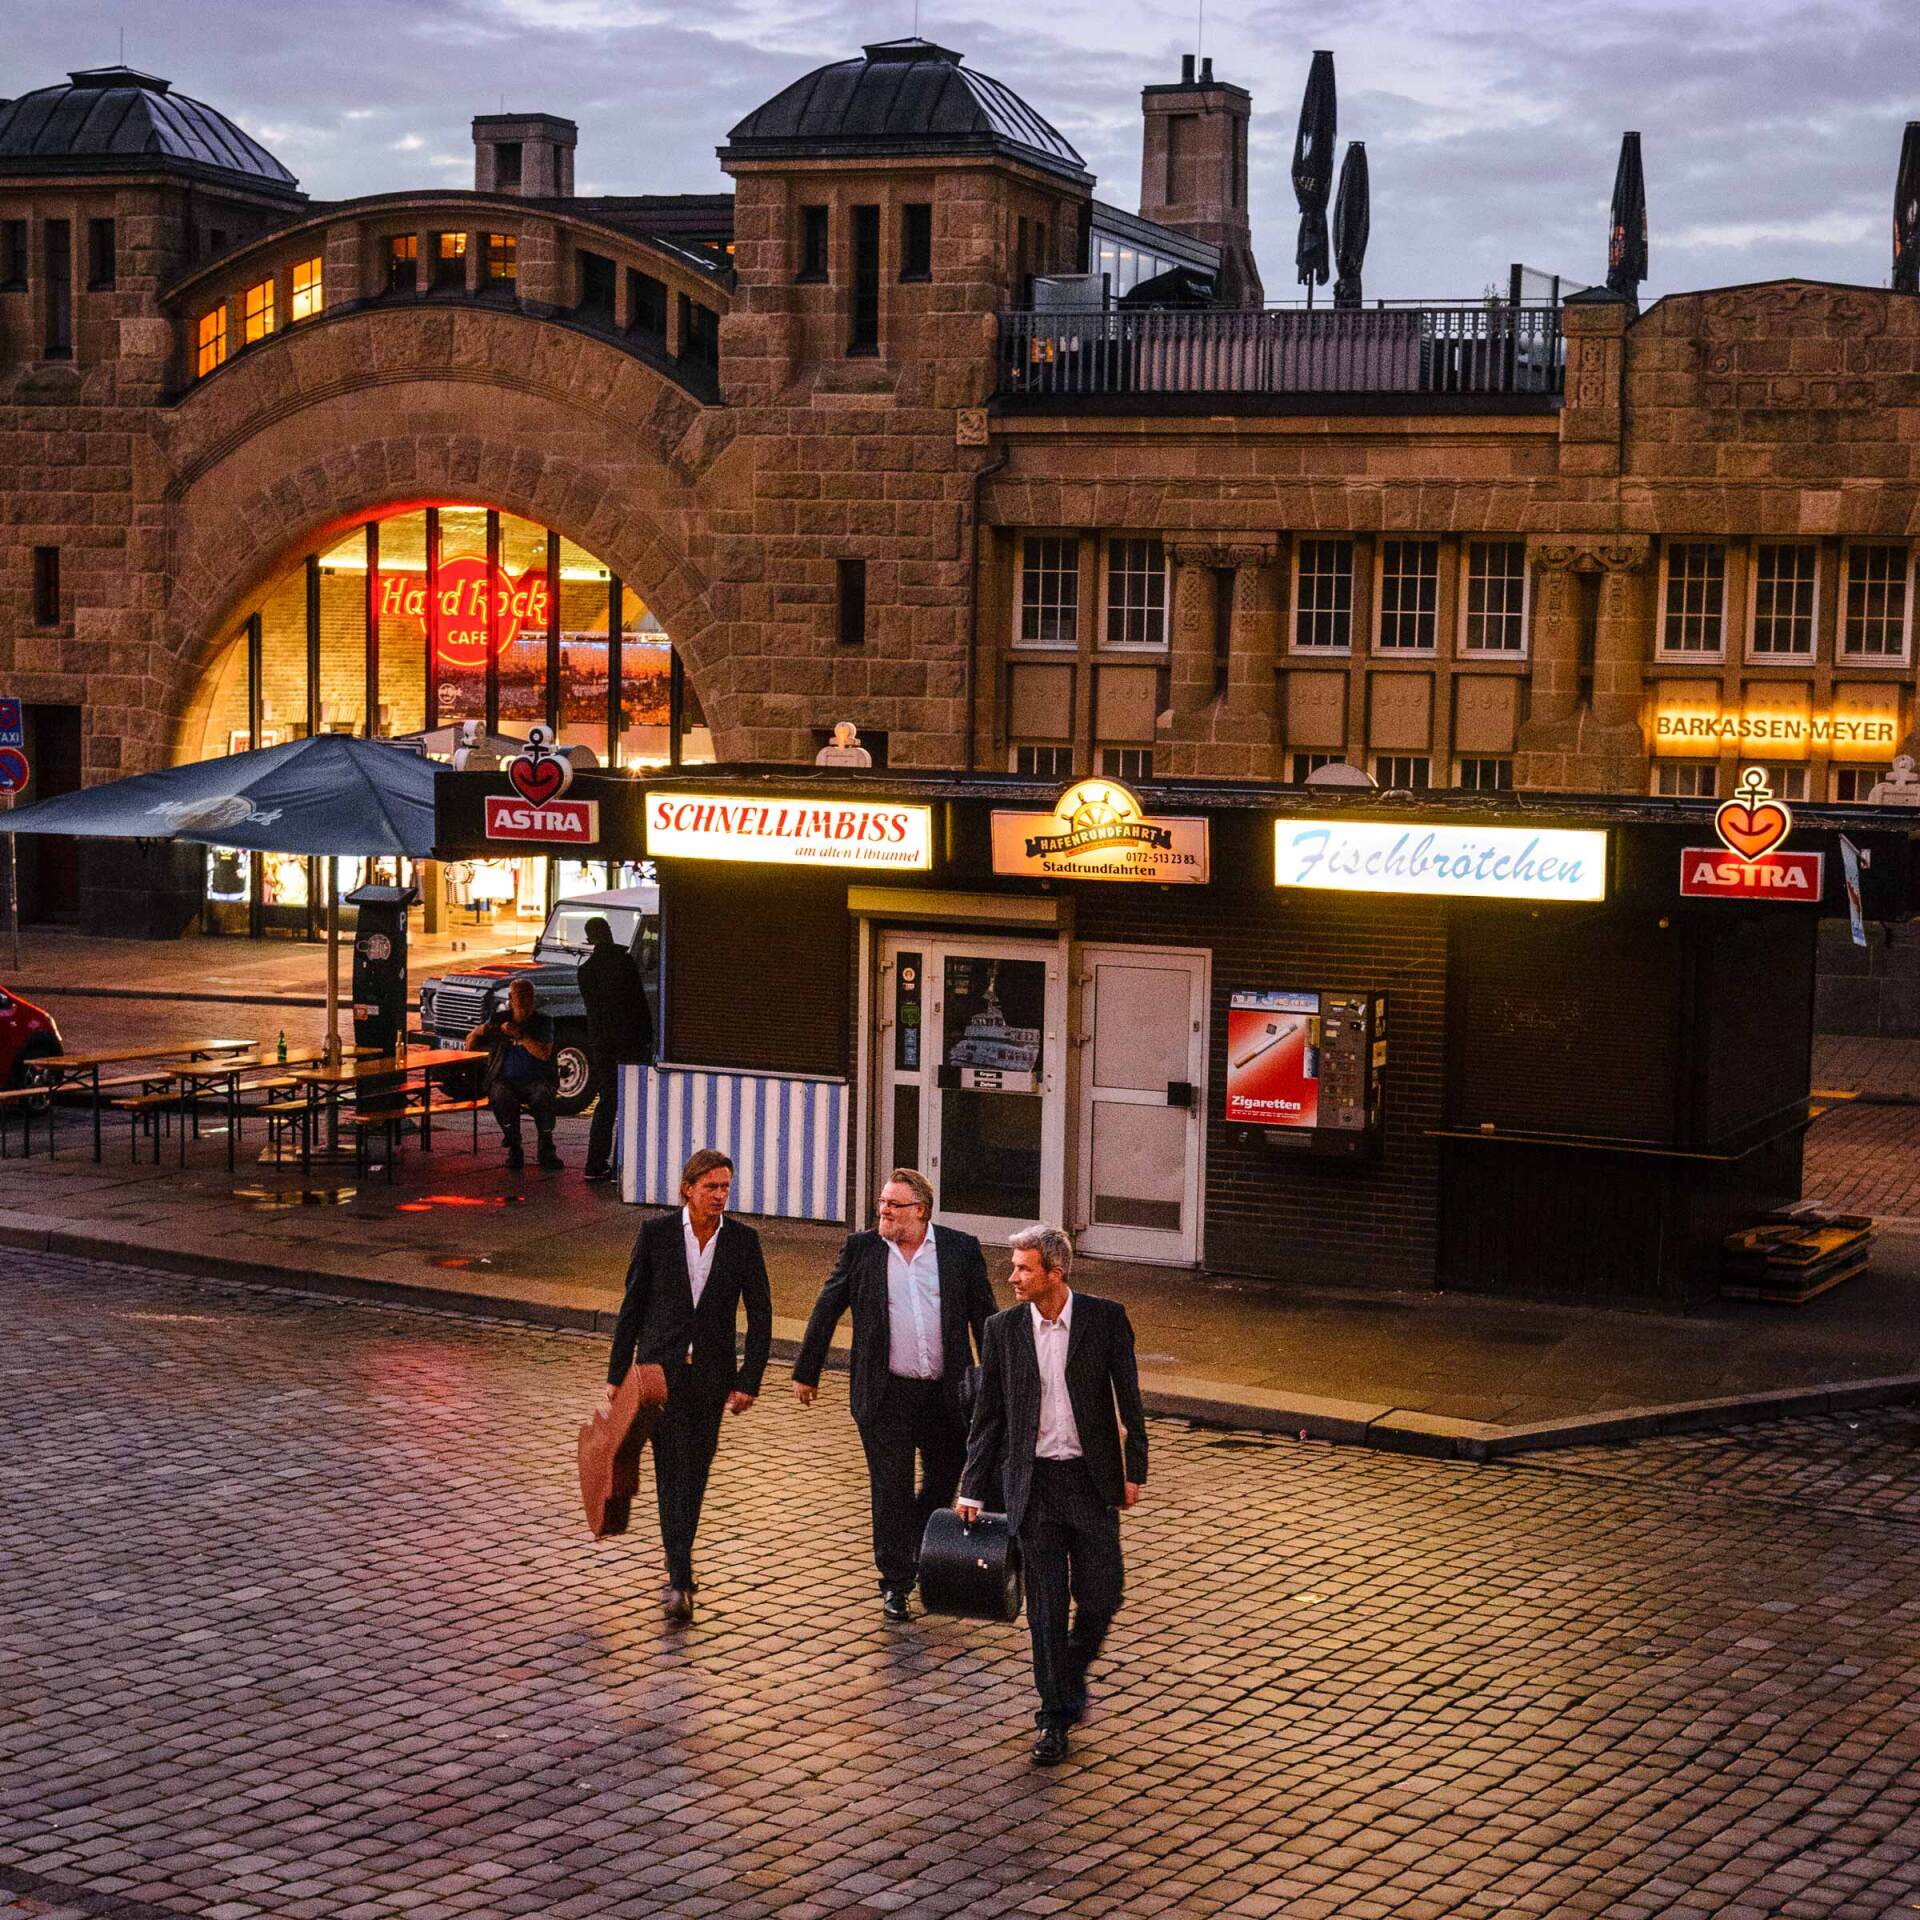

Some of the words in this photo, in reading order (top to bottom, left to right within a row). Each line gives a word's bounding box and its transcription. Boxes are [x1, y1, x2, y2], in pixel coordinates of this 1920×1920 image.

[0, 732, 20, 742] AXI
[494, 808, 583, 832] ASTRA
[654, 802, 909, 843] SCHNELLIMBISS
[1040, 826, 1158, 851] HAFENRUNDFAHRT
[795, 847, 816, 857] am
[819, 845, 852, 858] alten
[1126, 851, 1169, 864] 0172-513
[1171, 853, 1182, 864] 23
[1292, 828, 1586, 884] Fischbrötchen
[1043, 861, 1156, 876] Stadtrundfahrten
[1691, 862, 1809, 889] ASTRA
[1231, 1095, 1301, 1110] Zigaretten
